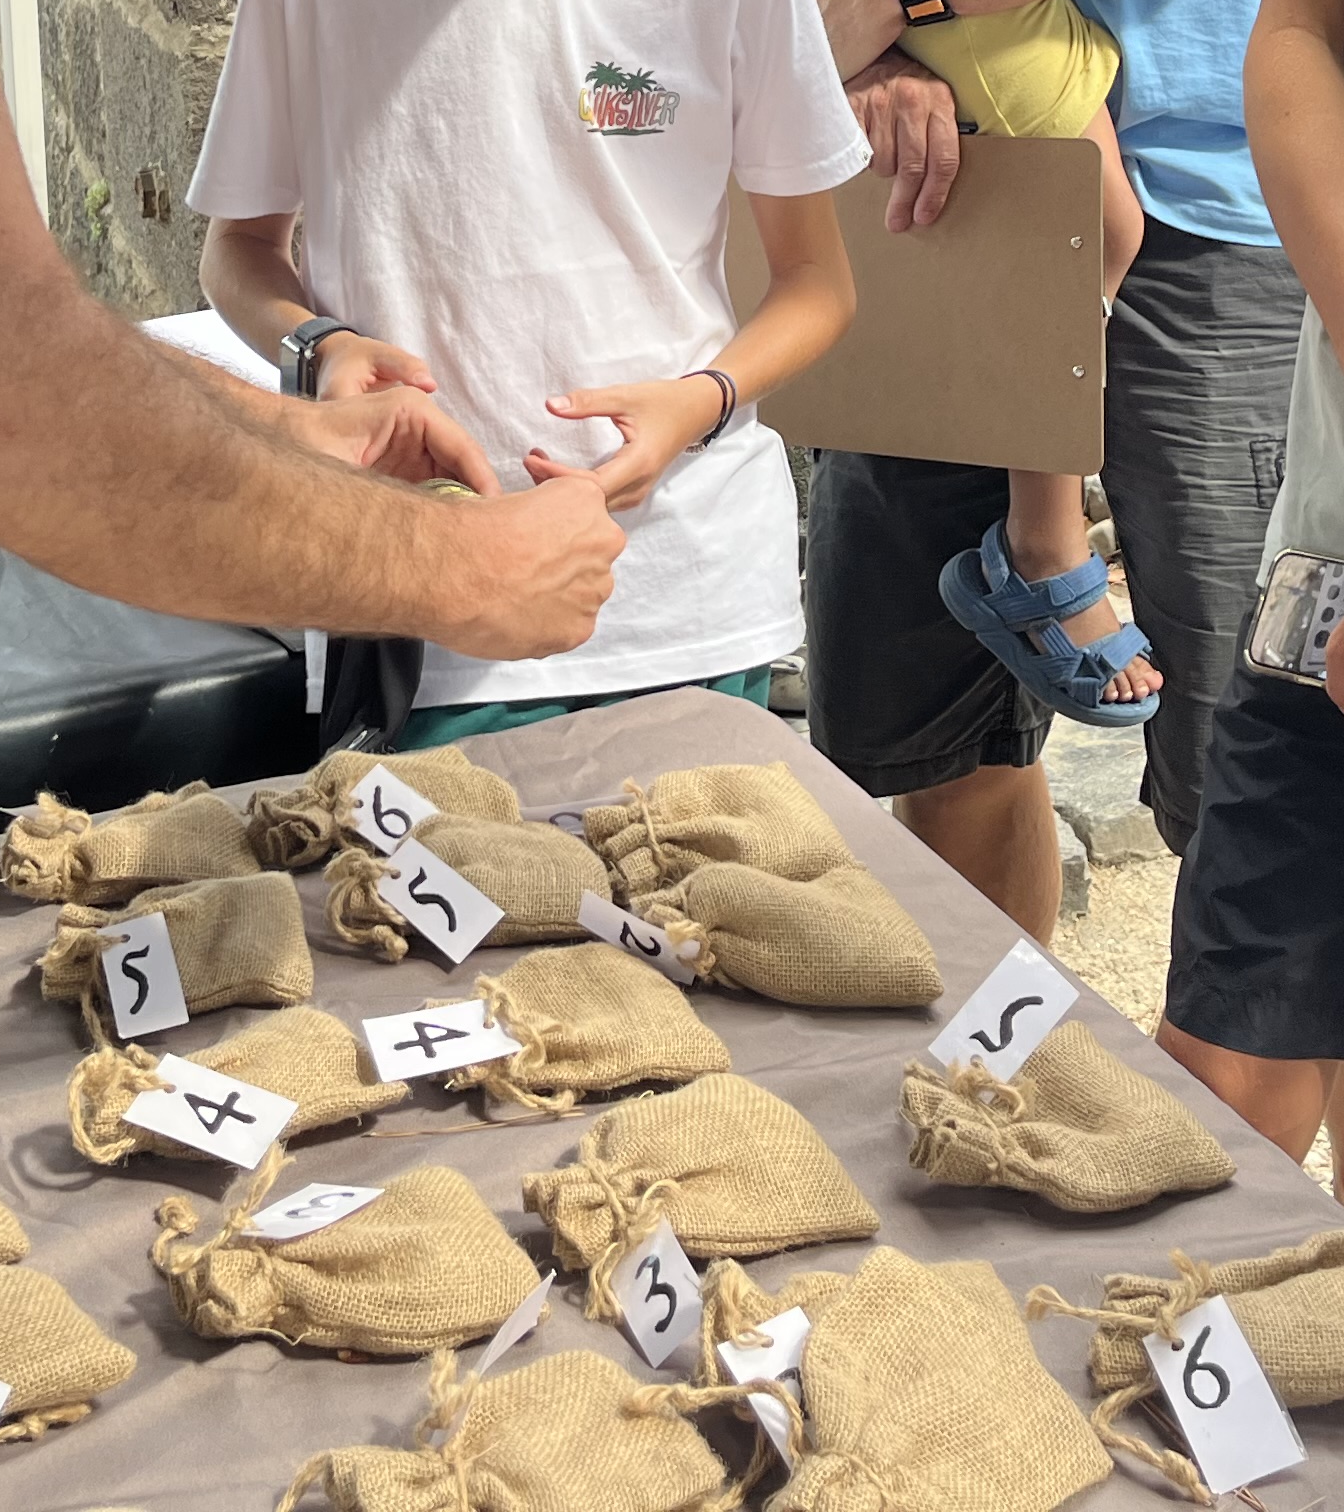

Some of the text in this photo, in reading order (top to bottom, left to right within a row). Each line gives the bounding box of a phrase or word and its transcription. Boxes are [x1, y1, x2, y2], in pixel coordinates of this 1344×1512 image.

[372, 784, 413, 839] 6
[407, 866, 457, 933] 5
[120, 944, 150, 1015] 5
[391, 1020, 469, 1059] 4
[183, 1089, 257, 1136] 4
[634, 1254, 678, 1333] 3
[1182, 1324, 1231, 1409] 6
